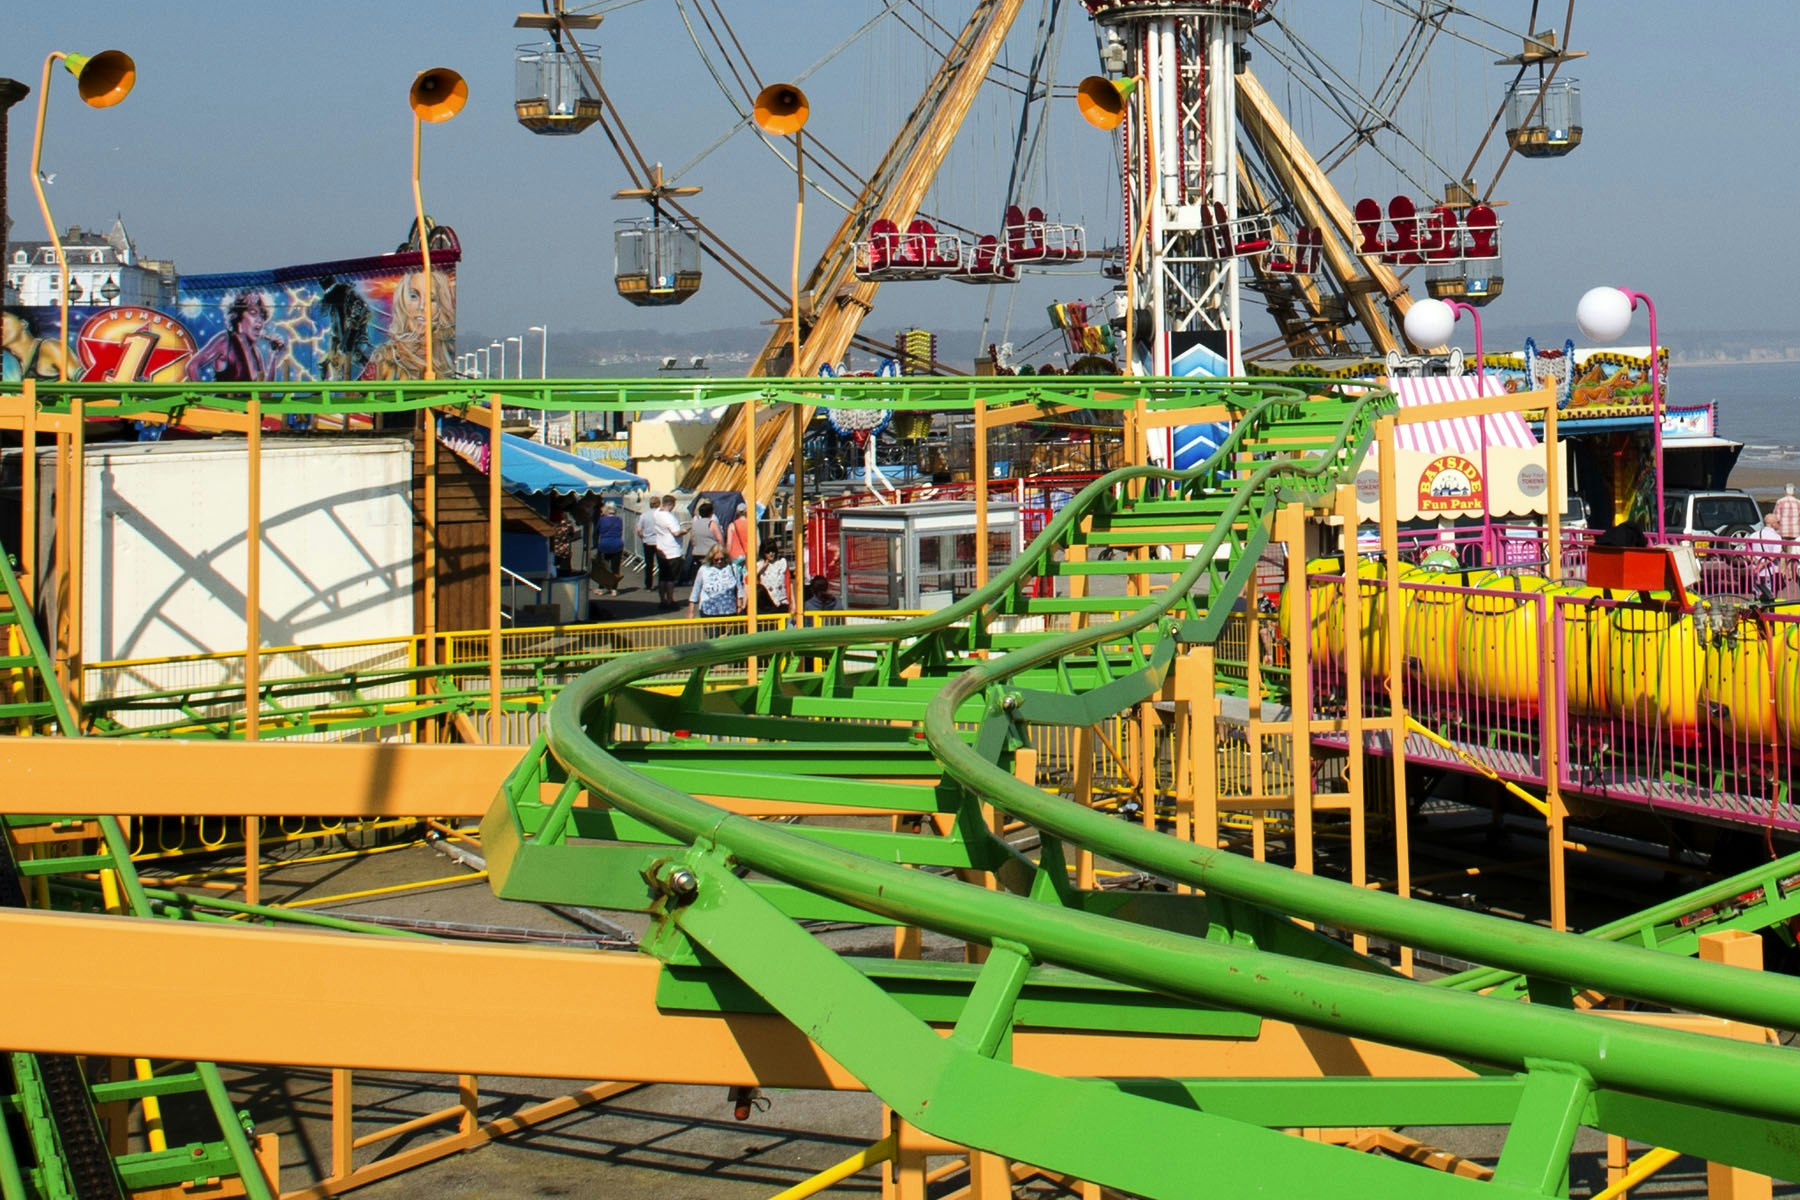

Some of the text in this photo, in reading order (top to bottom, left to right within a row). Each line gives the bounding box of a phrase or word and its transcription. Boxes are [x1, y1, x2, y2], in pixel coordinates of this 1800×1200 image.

[658, 276, 667, 286] 9
[1474, 280, 1482, 290] 2
[109, 311, 184, 337] NUMBER
[103, 332, 157, 382] 1
[993, 467, 1001, 477] 5
[1420, 457, 1482, 494] BAYSIDE
[1423, 498, 1482, 510] Fun Park
